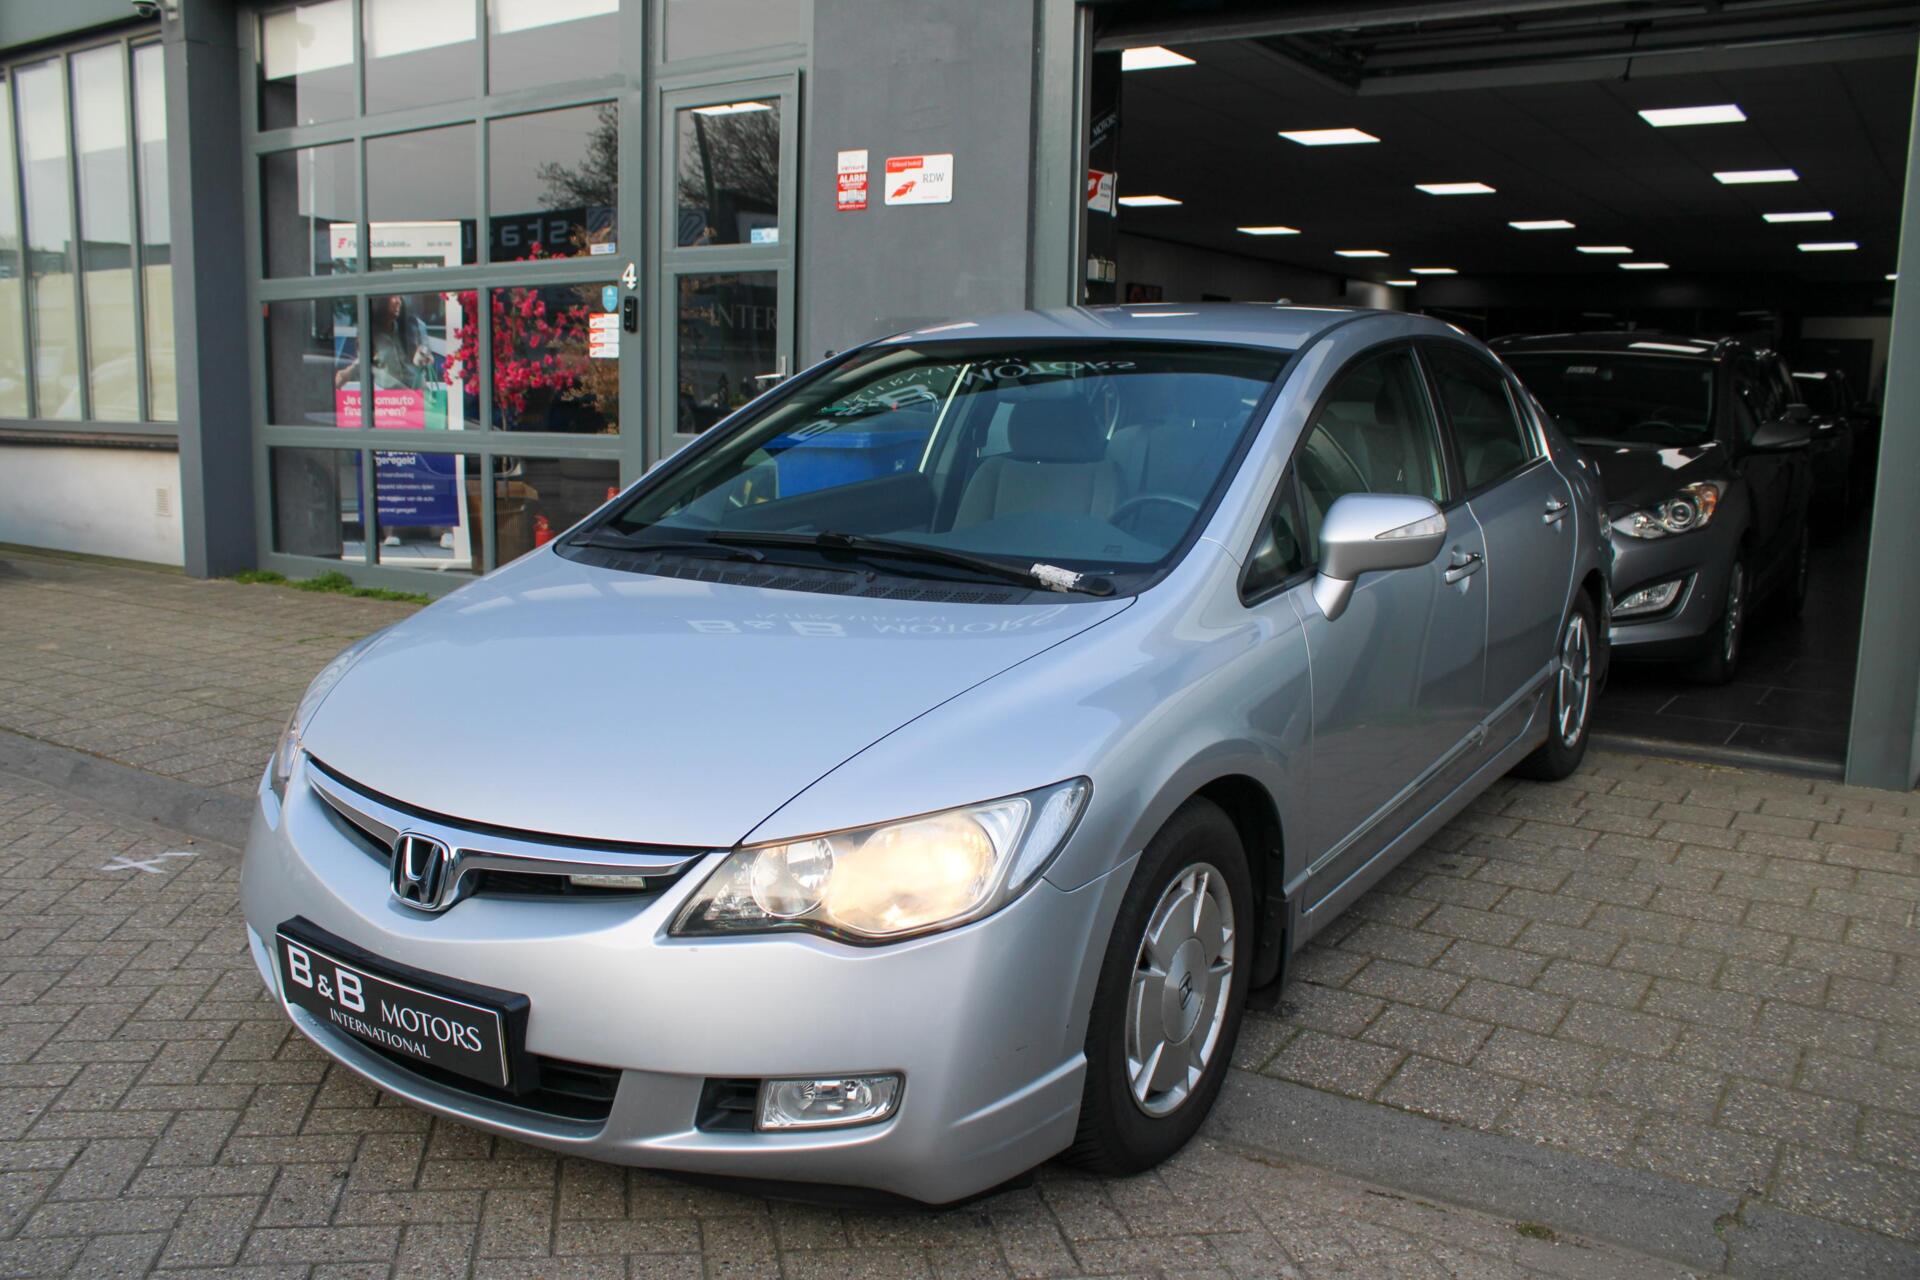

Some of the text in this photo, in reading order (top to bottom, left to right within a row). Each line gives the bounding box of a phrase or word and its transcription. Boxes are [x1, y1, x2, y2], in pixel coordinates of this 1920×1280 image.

[839, 173, 867, 184] ALARM
[923, 172, 945, 183] RDW
[622, 262, 638, 290] 4
[329, 1007, 431, 1060] INTERNATIONAL
[380, 999, 483, 1053] MOTORS
